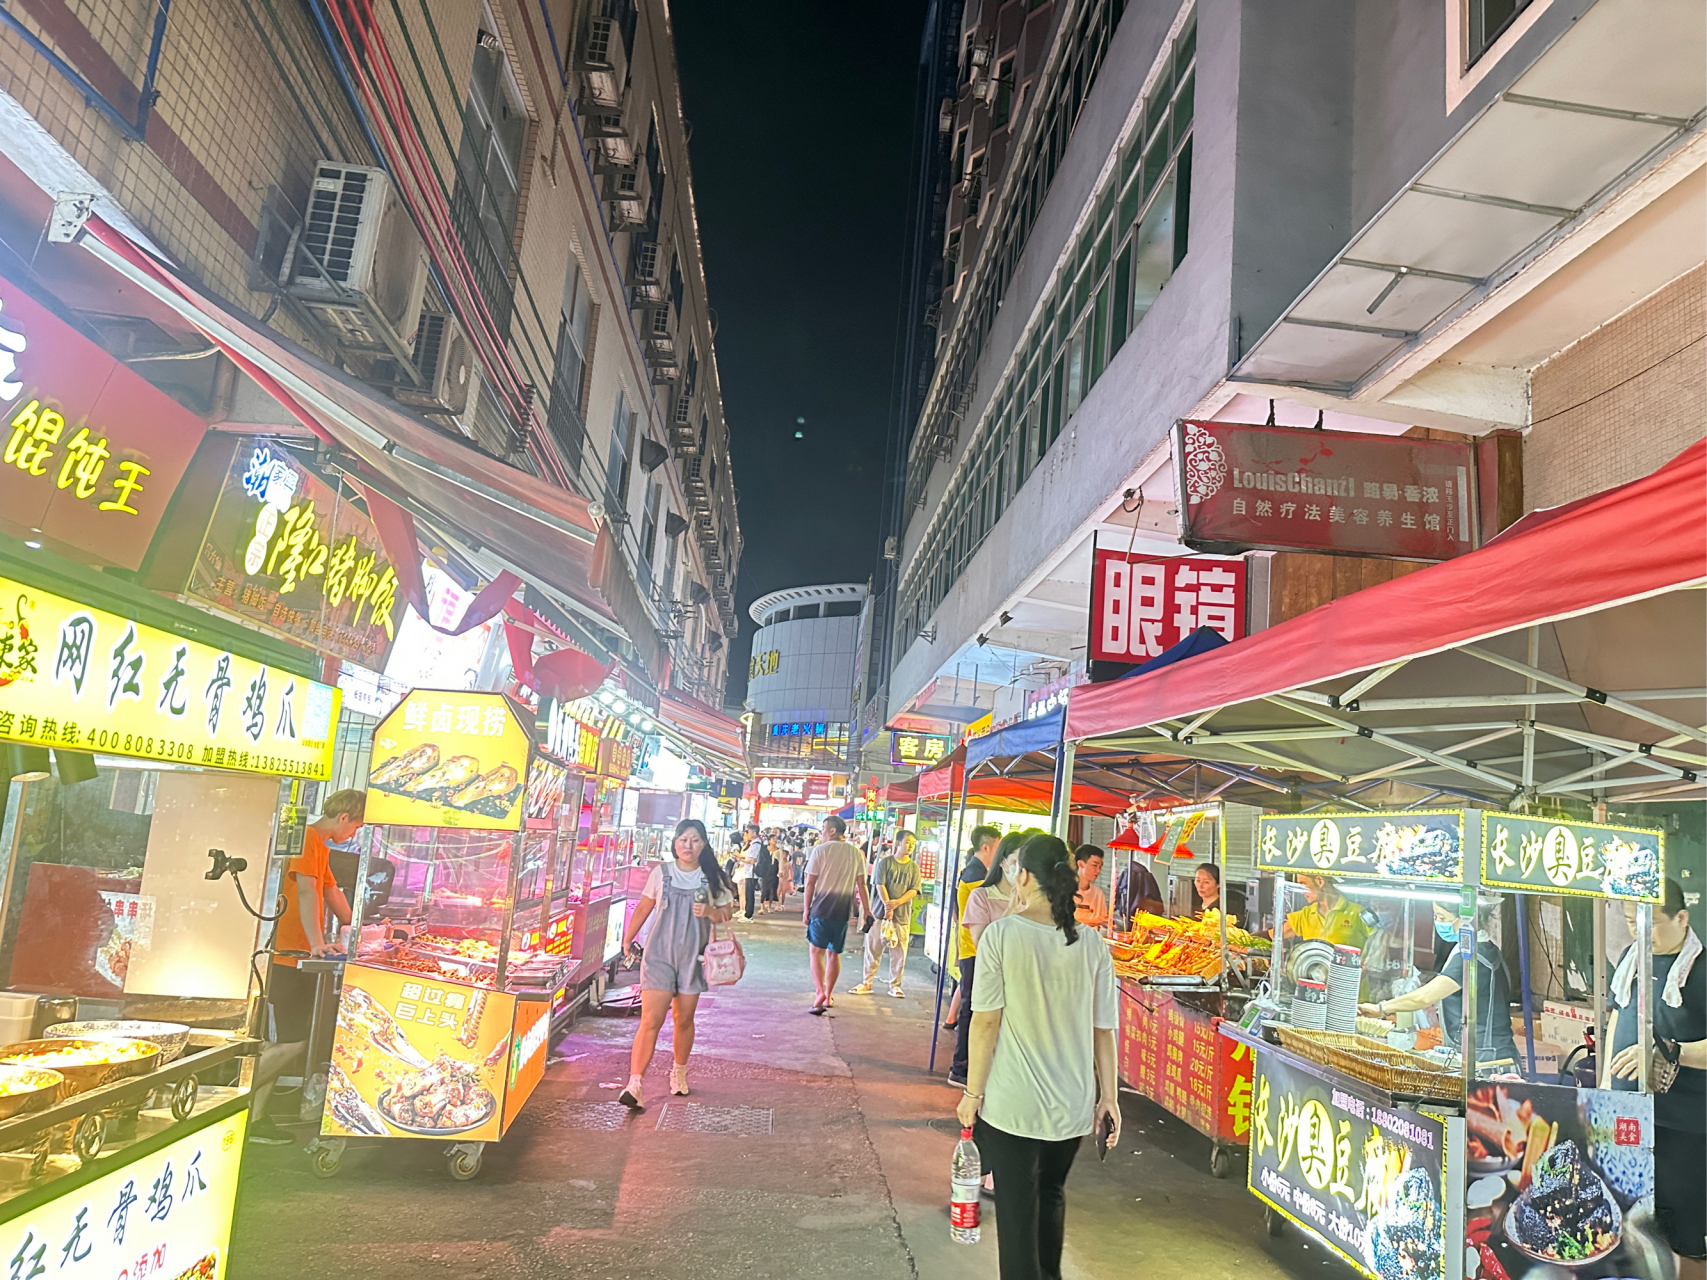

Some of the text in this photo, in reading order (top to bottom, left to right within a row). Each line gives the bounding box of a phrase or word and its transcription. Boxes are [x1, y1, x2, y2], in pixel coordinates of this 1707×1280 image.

[3, 400, 151, 515] 馄饨王
[1232, 498, 1441, 531] 自然疗法美容养生馆
[267, 501, 399, 642] 隆江猪脚饭
[1101, 558, 1236, 657] 眼镜
[56, 616, 296, 741] 网红无骨鸡爪
[402, 700, 507, 737] 鲜卤现捞
[898, 736, 944, 758] 客房
[400, 982, 467, 1010] 超过瘾
[395, 1001, 459, 1031] 巨上头
[1193, 1039, 1215, 1061] 15元/斤
[1190, 1057, 1214, 1082] 20元/斤
[1190, 1077, 1213, 1102] 18元/斤
[1619, 1122, 1636, 1132] 湖南
[1619, 1132, 1637, 1142] 美食
